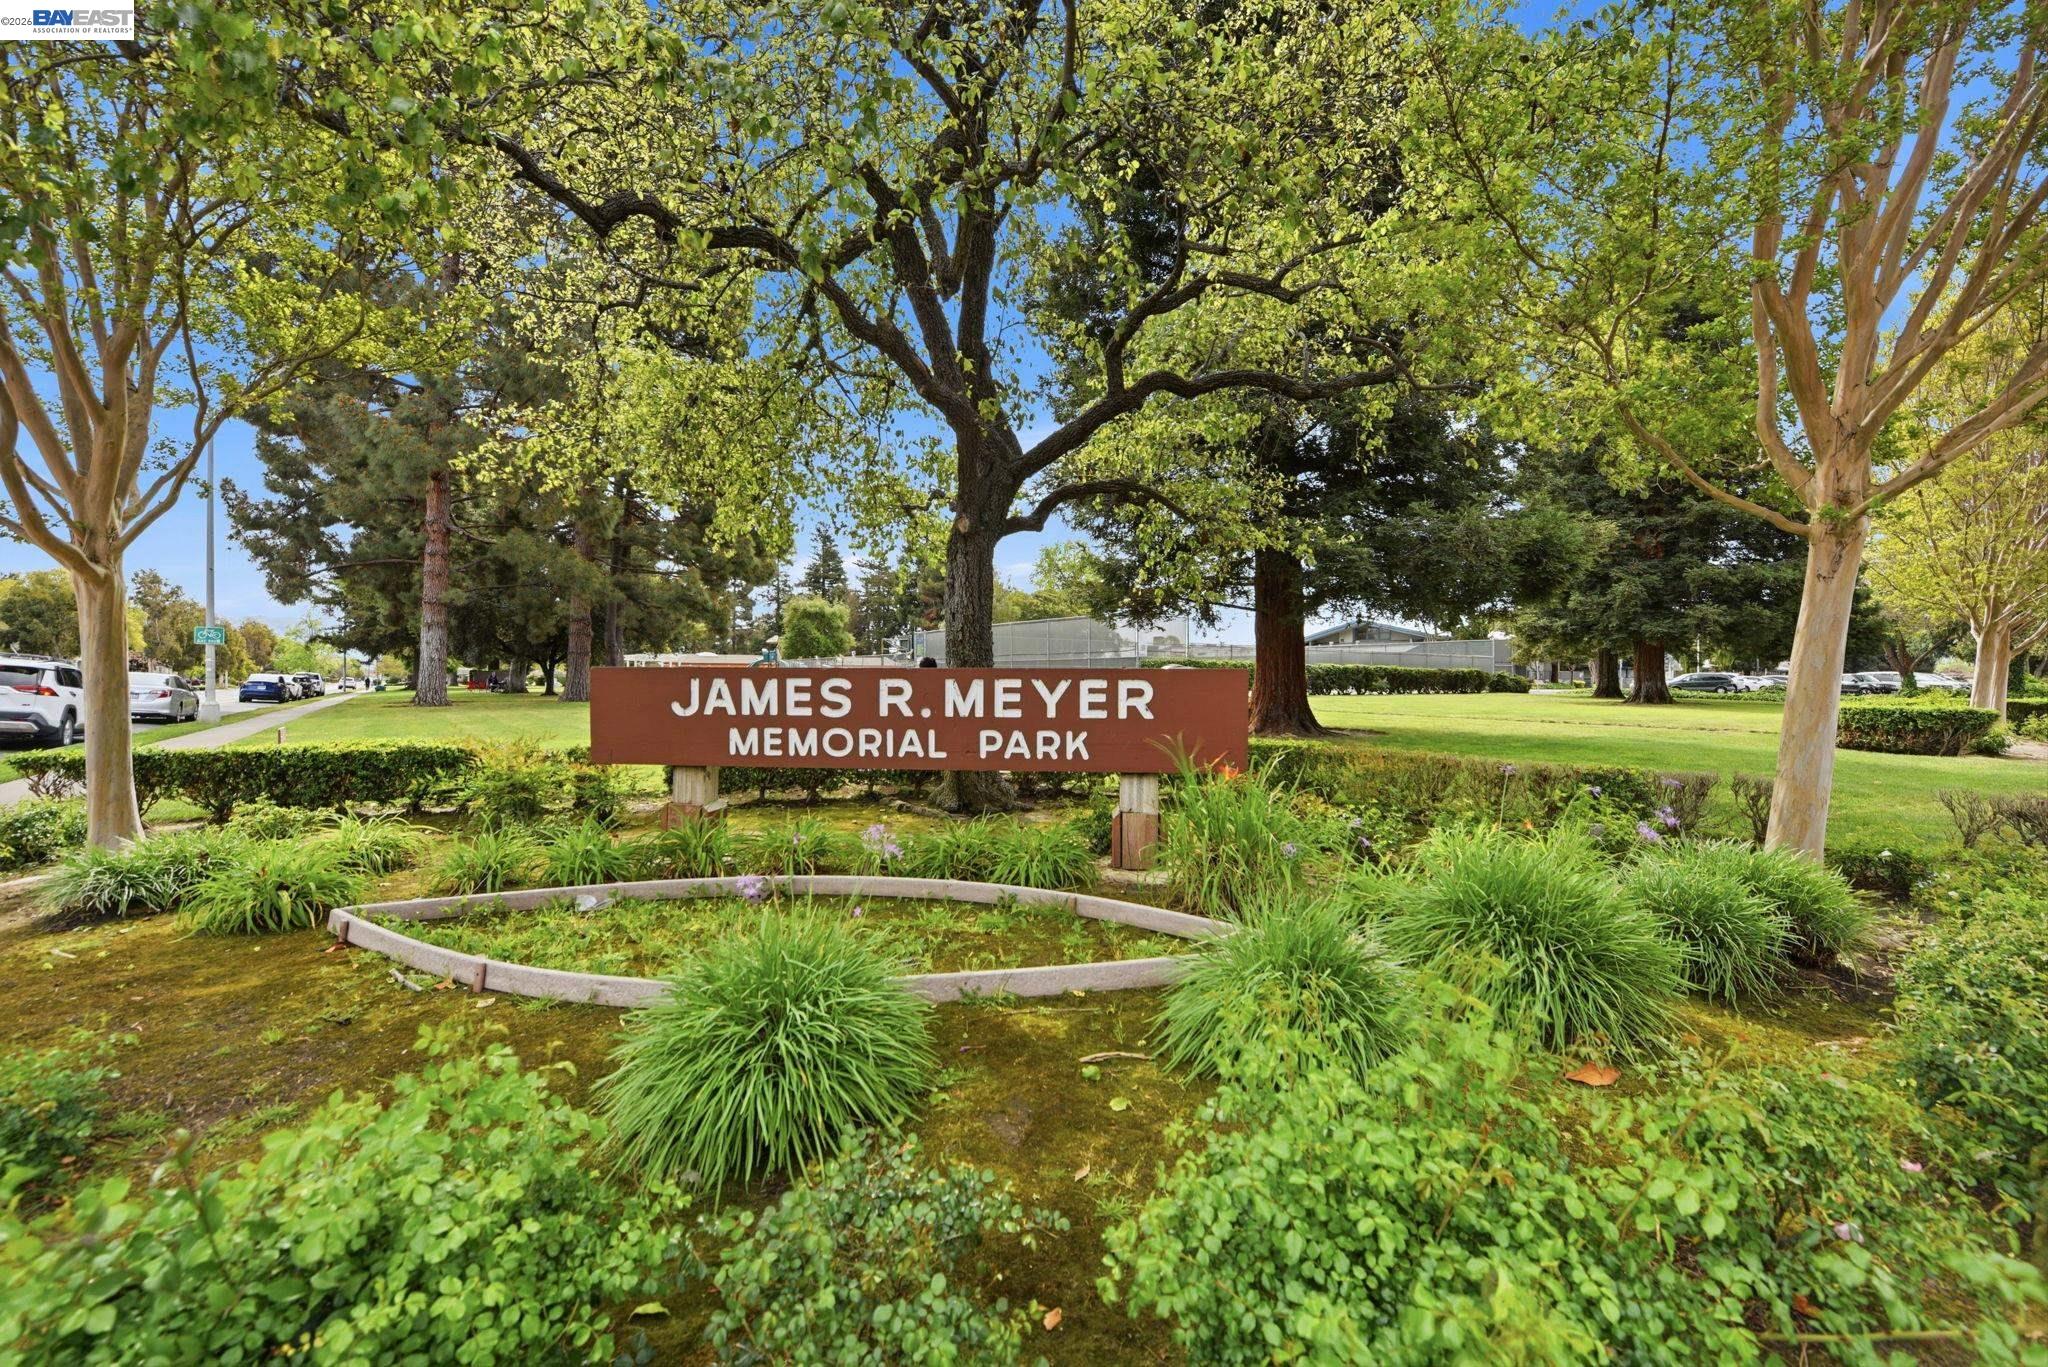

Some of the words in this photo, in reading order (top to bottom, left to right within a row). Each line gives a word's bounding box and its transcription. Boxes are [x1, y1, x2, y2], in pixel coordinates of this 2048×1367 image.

[671, 678, 852, 718] JAMES
[879, 678, 932, 719] R.
[944, 678, 1154, 720] MEYER
[729, 727, 948, 759] MEMORIAL
[979, 729, 1090, 761] PARK
